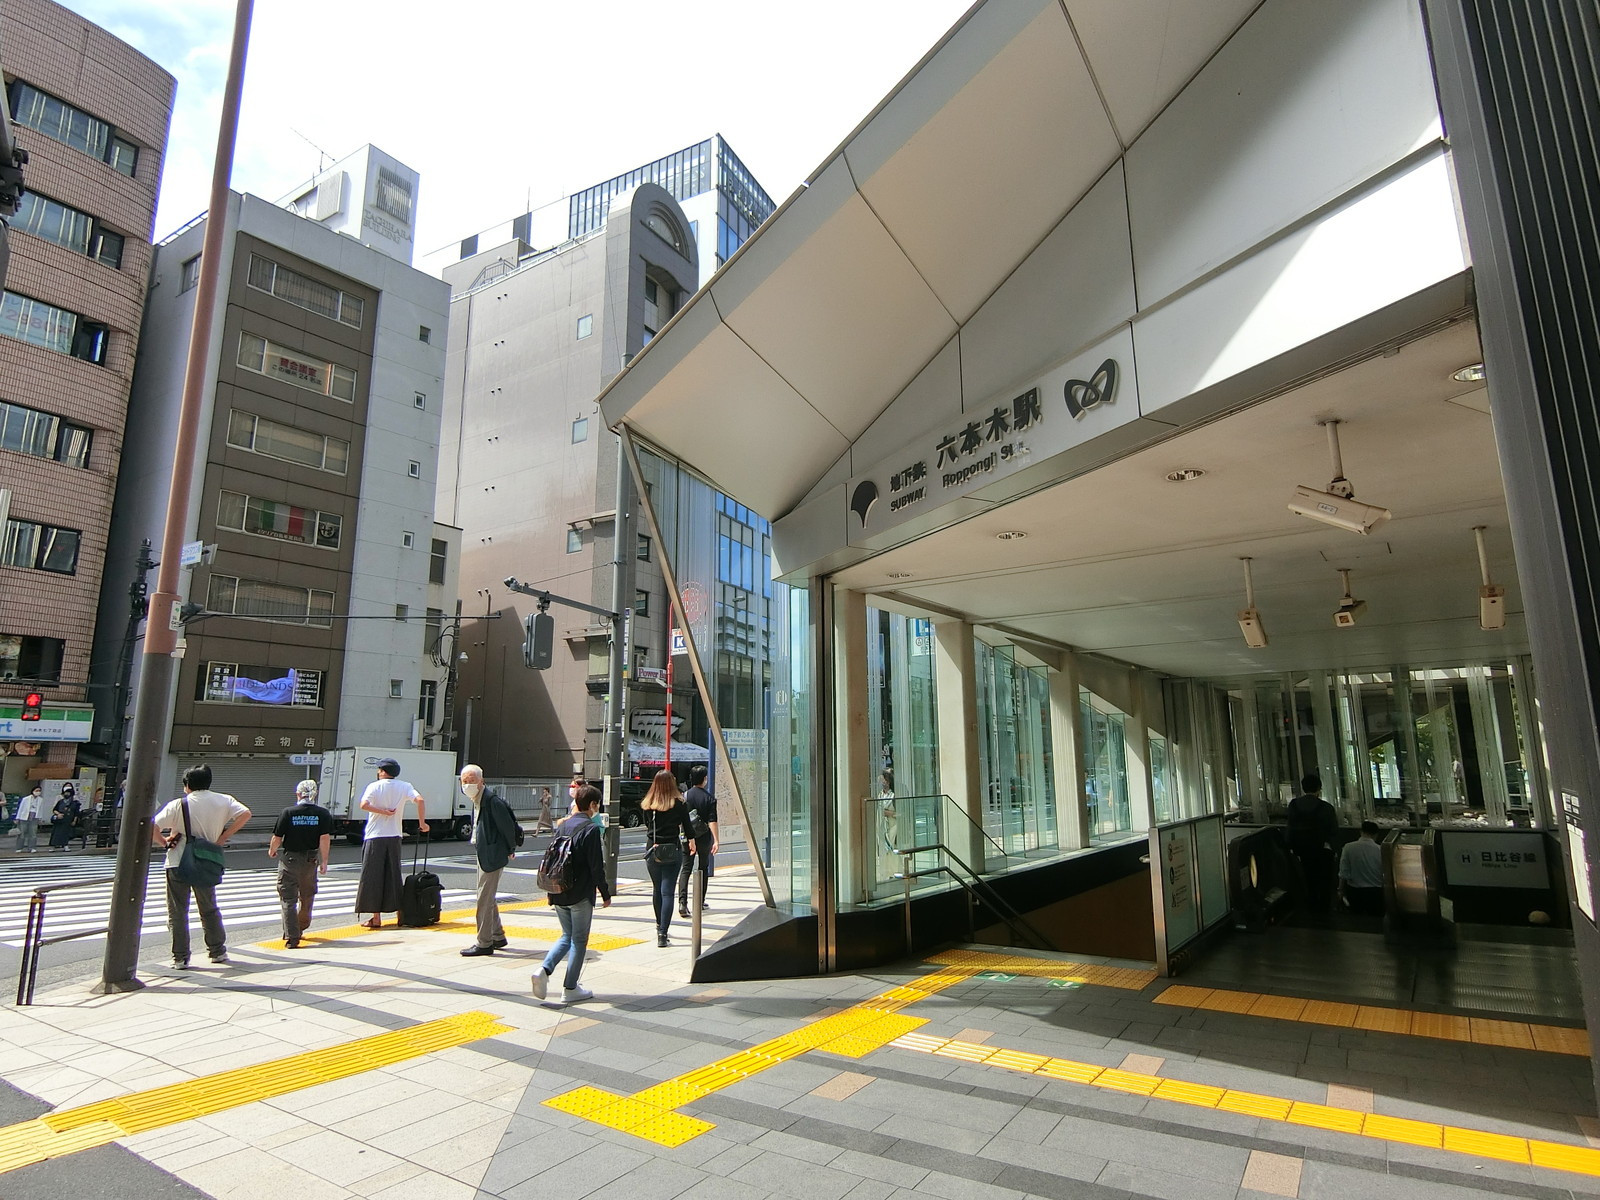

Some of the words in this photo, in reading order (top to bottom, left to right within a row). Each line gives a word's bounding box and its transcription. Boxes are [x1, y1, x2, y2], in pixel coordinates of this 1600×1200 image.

[936, 387, 1042, 470] 六本木駅
[890, 461, 927, 492] 地下鉄
[942, 452, 997, 488] Roppongi
[890, 487, 927, 512] SUBWAY
[639, 668, 659, 678] Power
[199, 734, 316, 747] 立原金物店
[1461, 854, 1471, 863] H
[1481, 851, 1537, 862] 日比谷線
